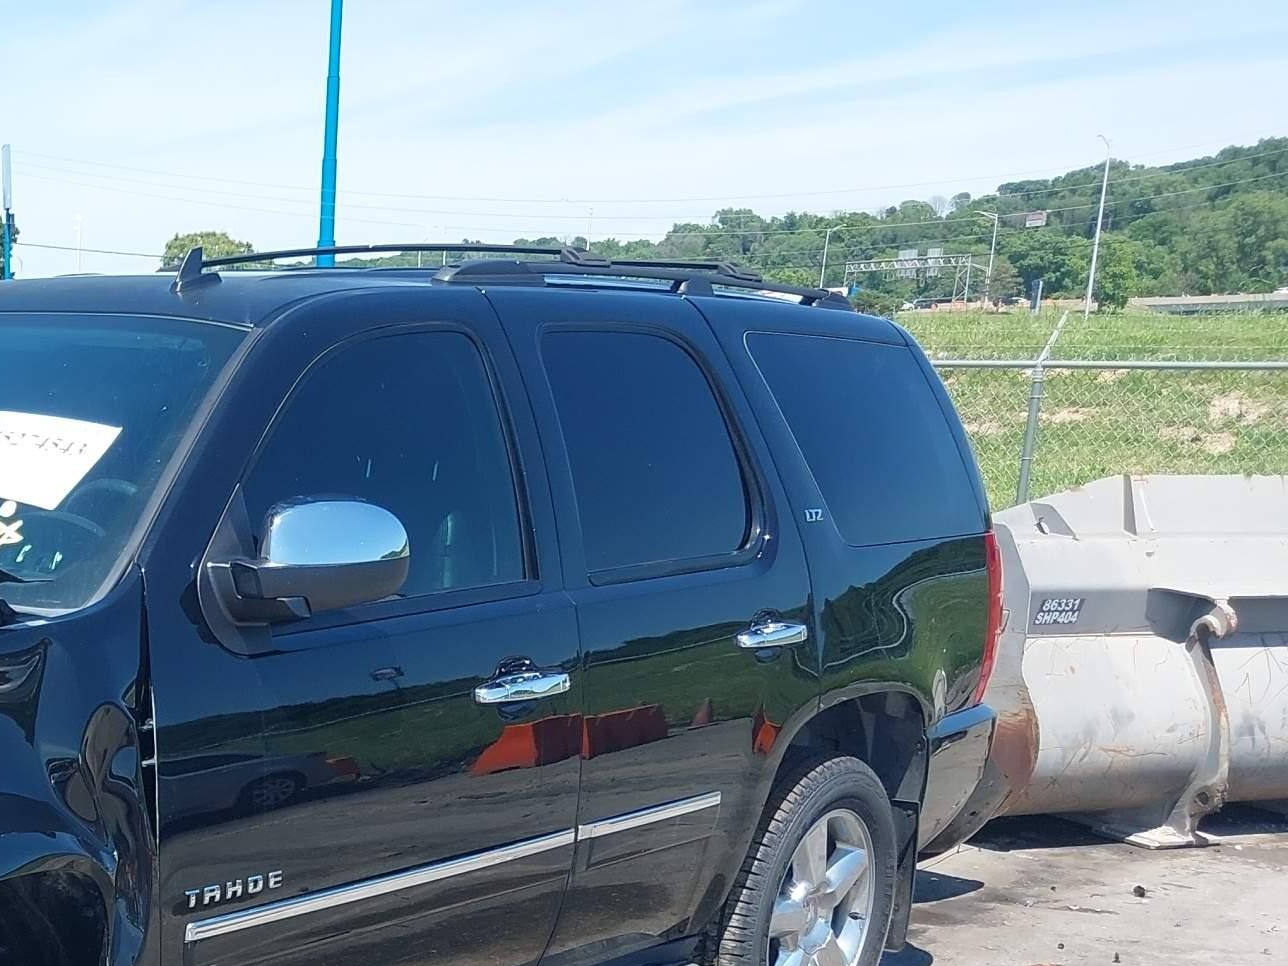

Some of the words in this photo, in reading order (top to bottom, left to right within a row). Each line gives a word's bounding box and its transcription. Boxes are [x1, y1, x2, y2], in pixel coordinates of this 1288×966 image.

[804, 508, 824, 522] LTZ
[1042, 598, 1081, 612] 86331
[1034, 610, 1080, 625] SHP404
[184, 869, 283, 908] TAHOE
